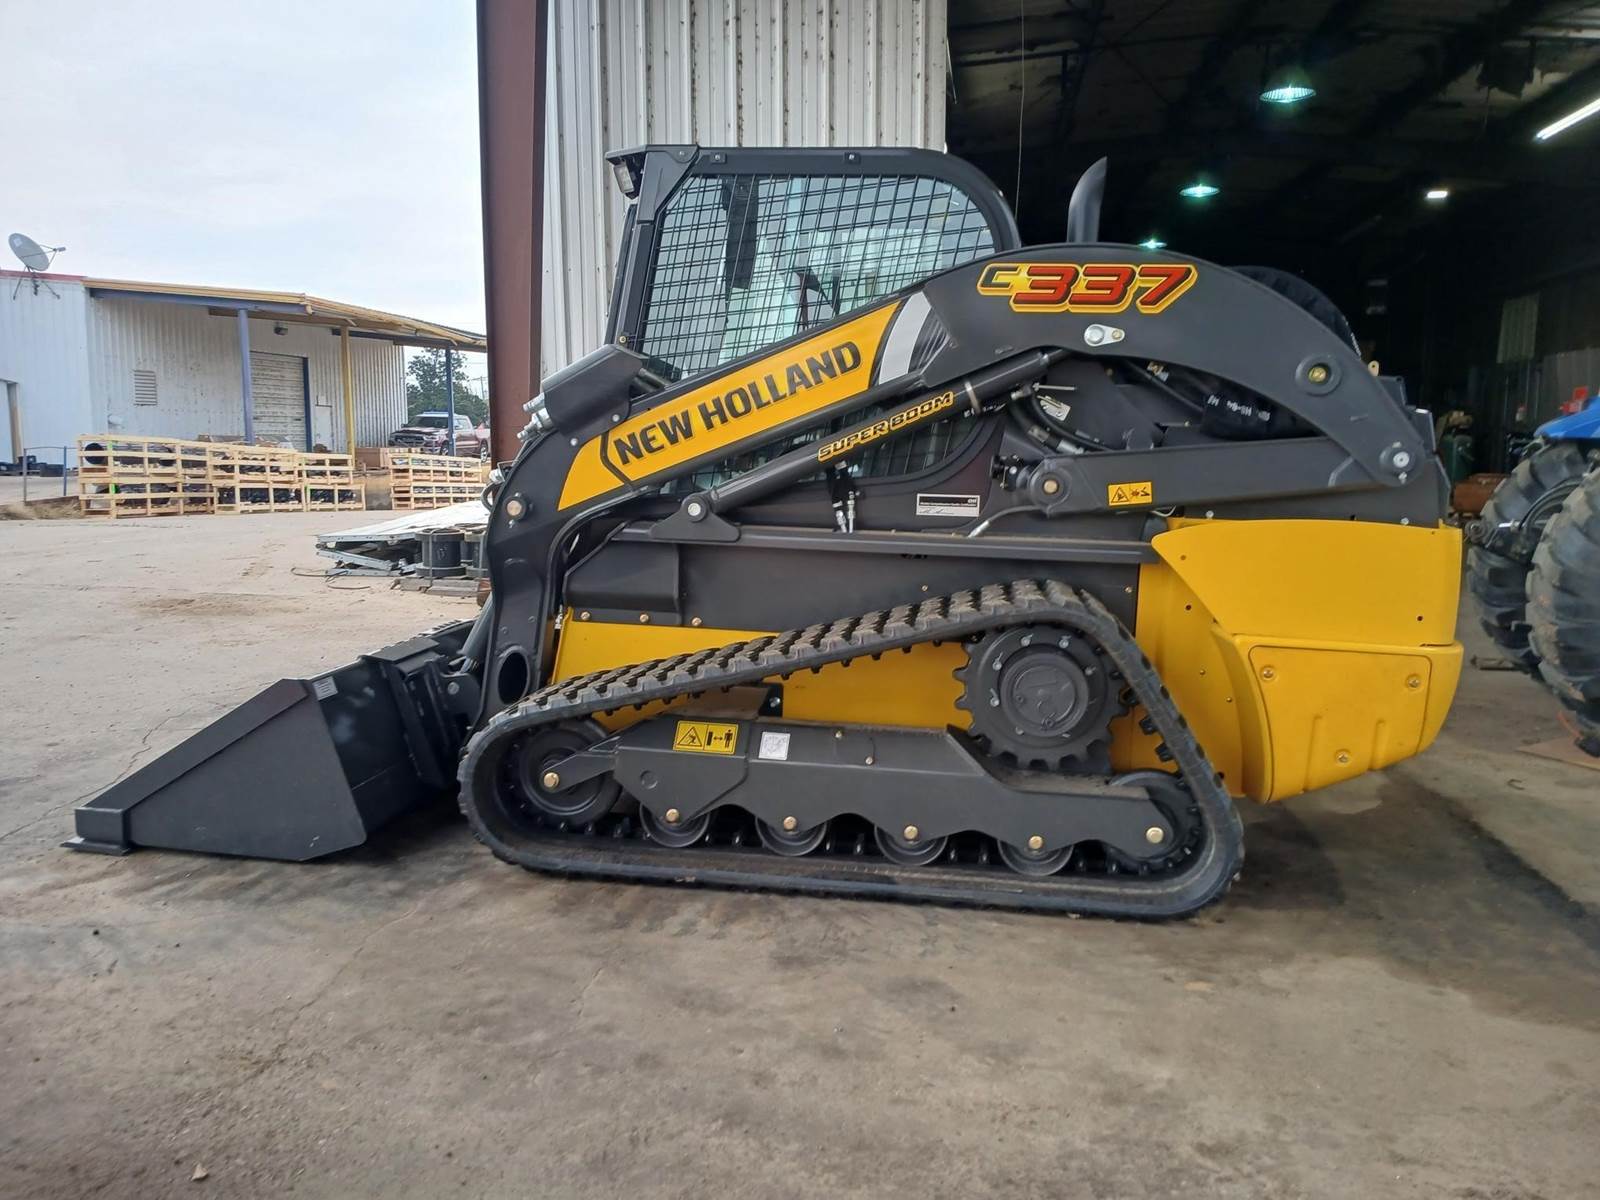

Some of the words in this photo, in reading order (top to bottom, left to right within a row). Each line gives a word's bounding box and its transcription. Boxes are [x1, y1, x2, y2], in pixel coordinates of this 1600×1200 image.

[977, 263, 1198, 313] C337
[613, 410, 694, 466] NEW
[697, 341, 862, 431] HOLLAND
[818, 420, 889, 462] SUPER
[889, 391, 954, 431] BOOM
